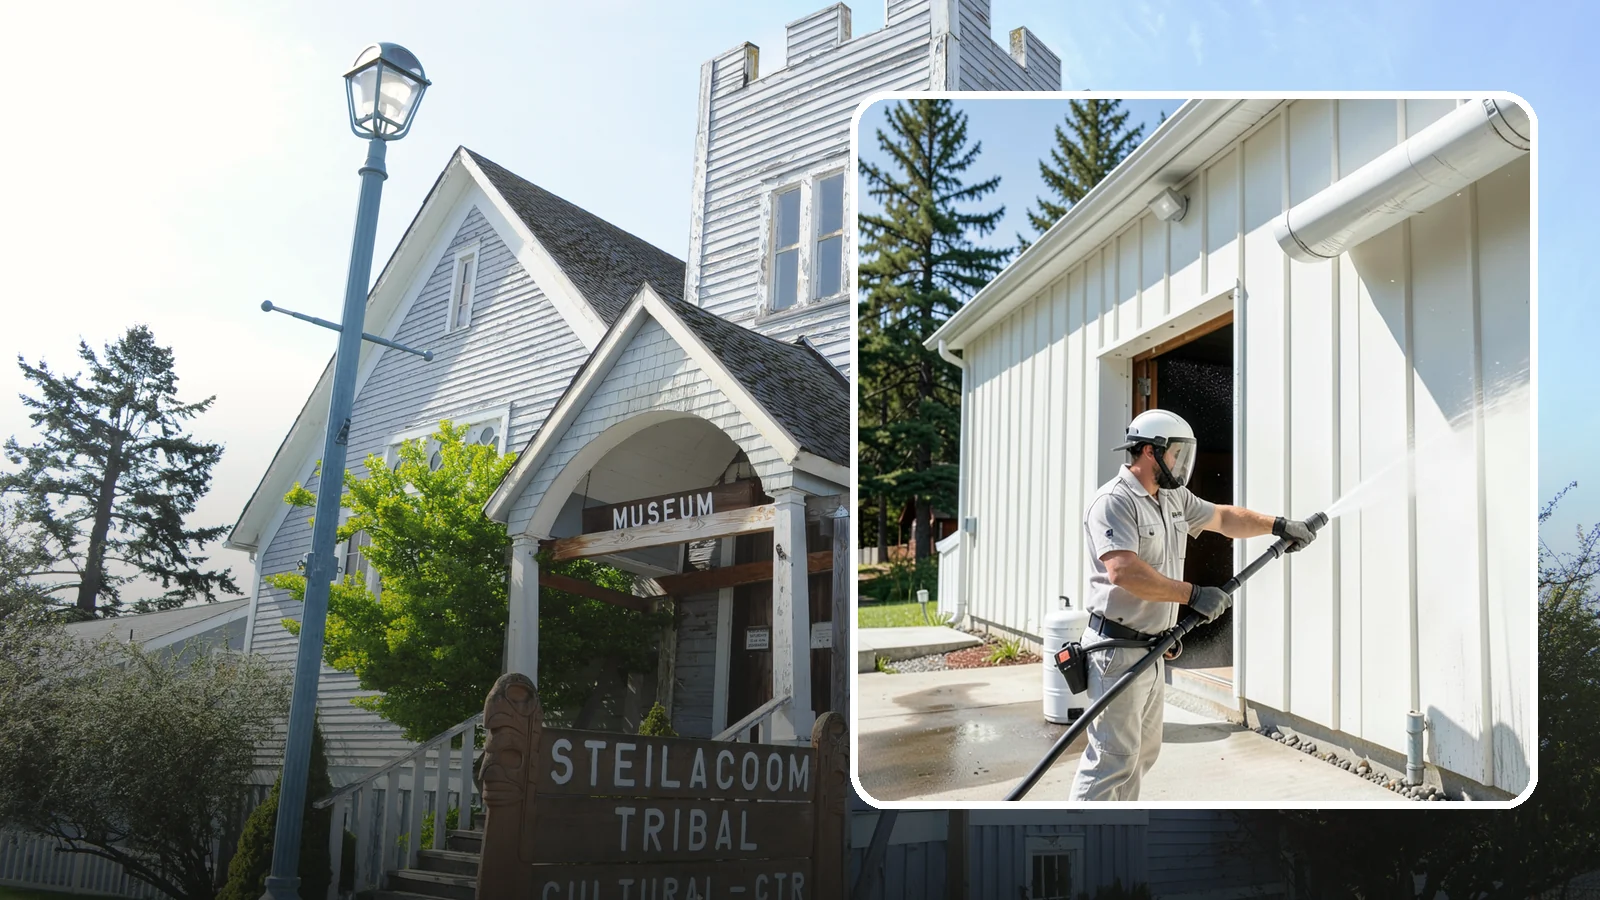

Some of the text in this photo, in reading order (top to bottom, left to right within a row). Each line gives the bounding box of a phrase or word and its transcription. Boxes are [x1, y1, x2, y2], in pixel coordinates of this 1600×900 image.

[613, 491, 713, 530] MUSEUM
[551, 738, 810, 792] STEILACOOM
[615, 807, 758, 852] TRIBAL
